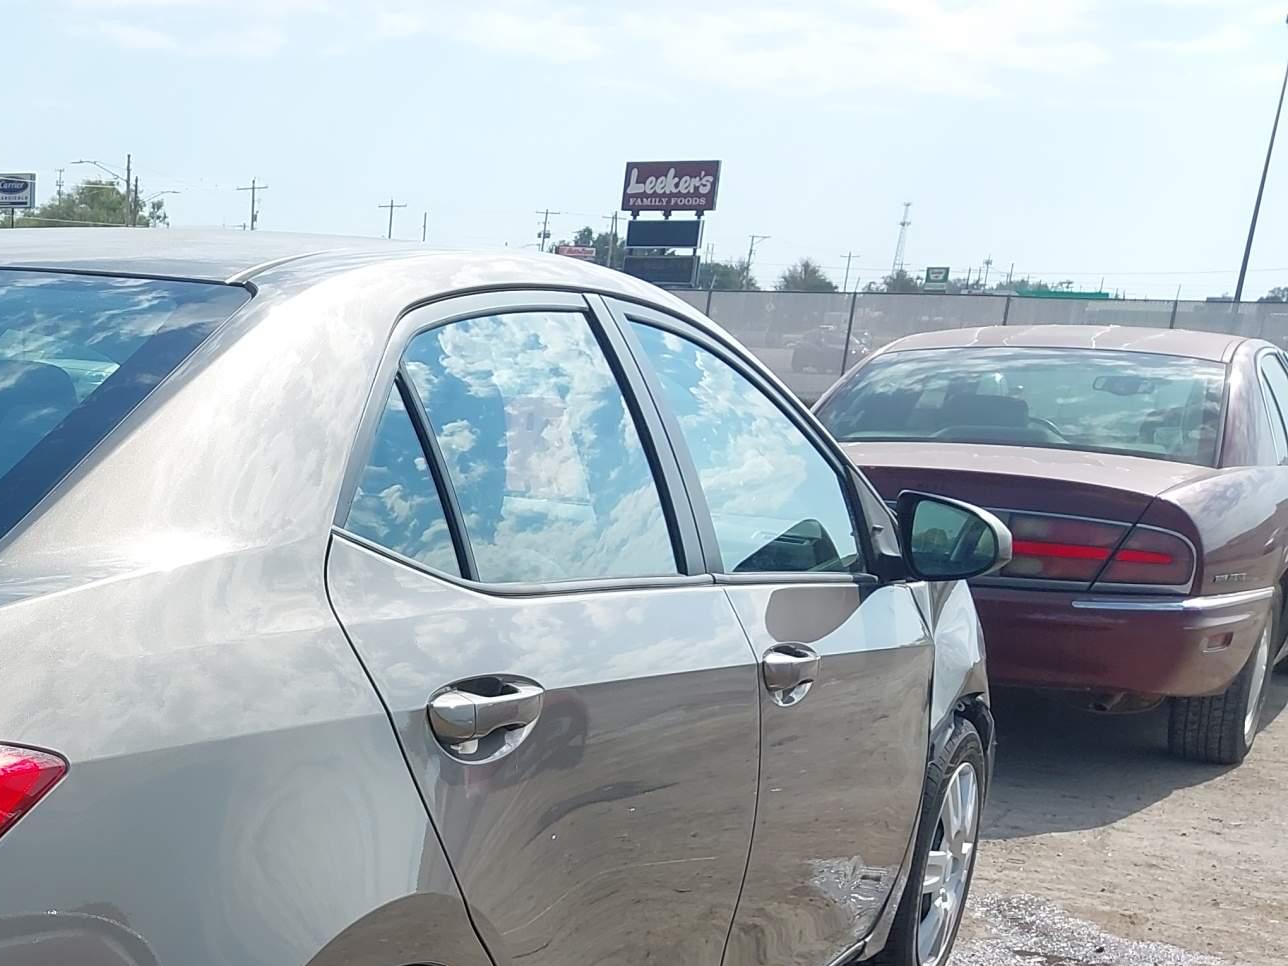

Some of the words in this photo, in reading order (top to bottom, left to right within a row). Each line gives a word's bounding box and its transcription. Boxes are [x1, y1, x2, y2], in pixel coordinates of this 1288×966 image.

[626, 167, 714, 194] Leeker's
[629, 197, 668, 206] FAMILY
[670, 197, 706, 206] FOODS
